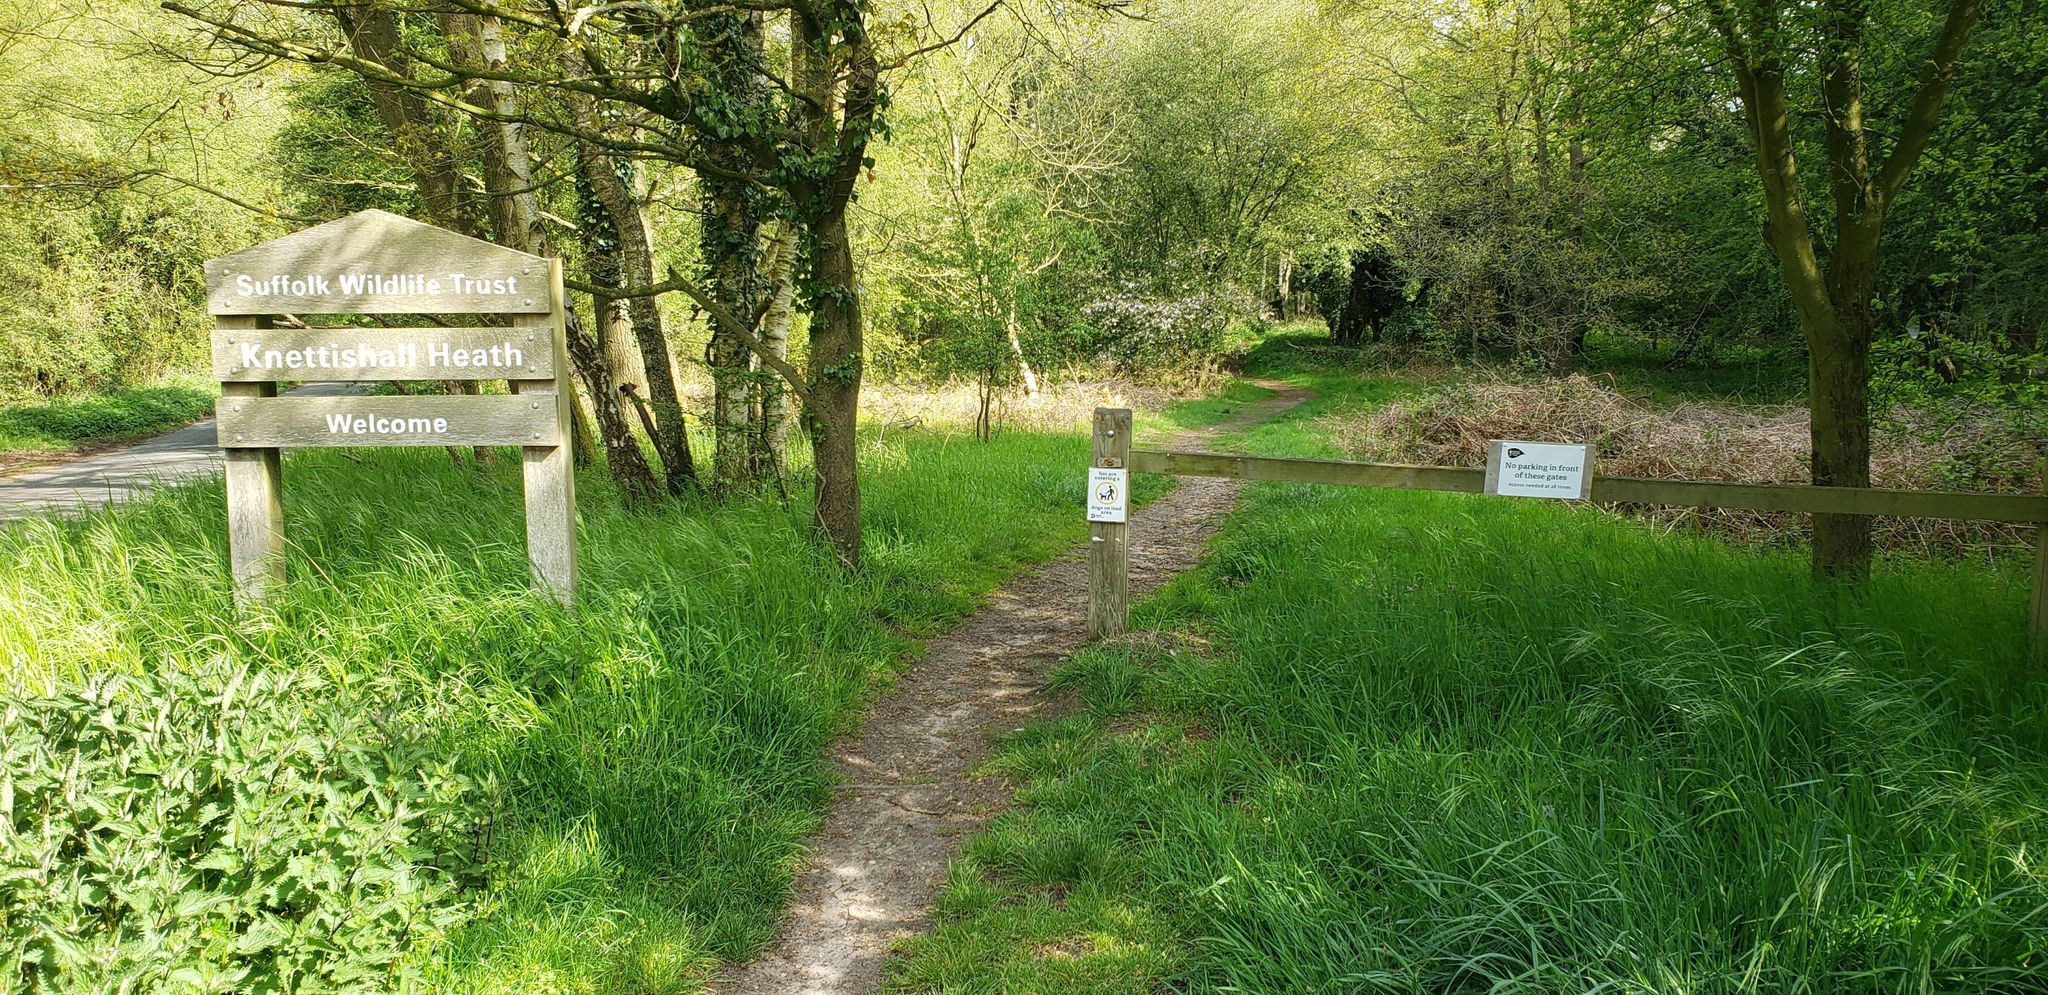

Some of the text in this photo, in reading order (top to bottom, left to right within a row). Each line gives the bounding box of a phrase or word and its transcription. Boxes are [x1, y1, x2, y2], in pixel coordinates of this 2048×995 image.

[236, 273, 518, 297] Suffolk Wildlife Trust
[241, 342, 523, 369] Knettishall Heath
[326, 413, 448, 435] Welcome
[1518, 463, 1548, 472] parking
[1558, 464, 1579, 472] front
[1525, 472, 1545, 480] these
